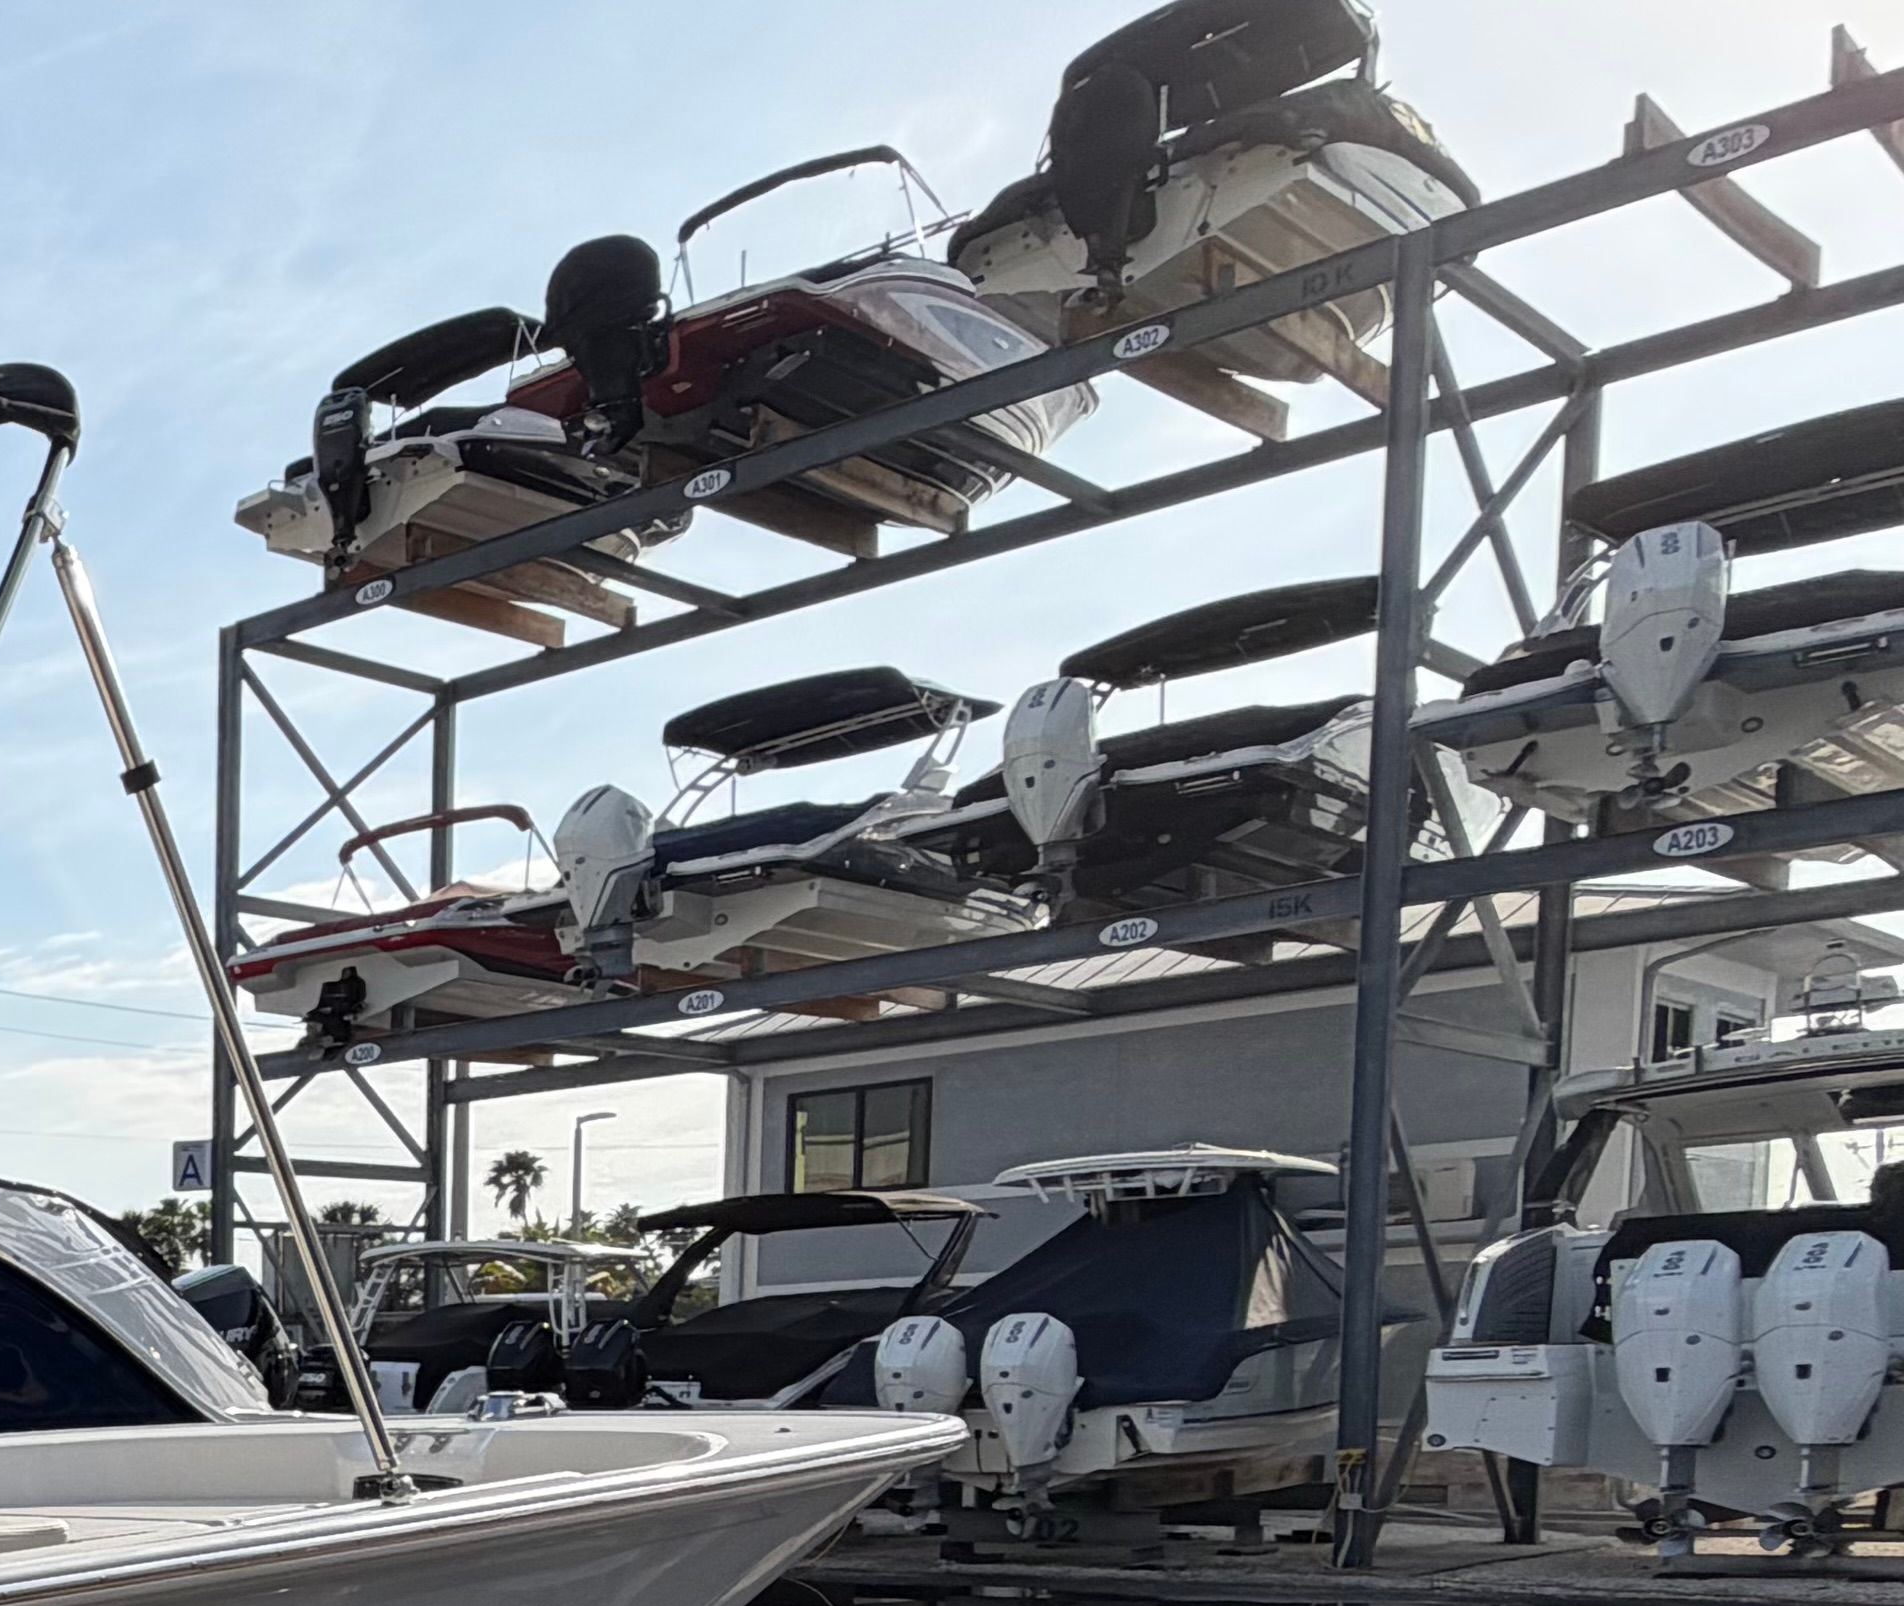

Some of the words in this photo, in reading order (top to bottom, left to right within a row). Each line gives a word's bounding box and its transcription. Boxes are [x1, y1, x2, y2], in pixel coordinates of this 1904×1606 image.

[1700, 127, 1755, 164] A303
[1122, 327, 1160, 356] A302
[691, 471, 721, 496] A301
[1667, 825, 1719, 853] A203
[1108, 920, 1147, 944] A202
[685, 992, 715, 1012] A201
[178, 1153, 204, 1187] A
